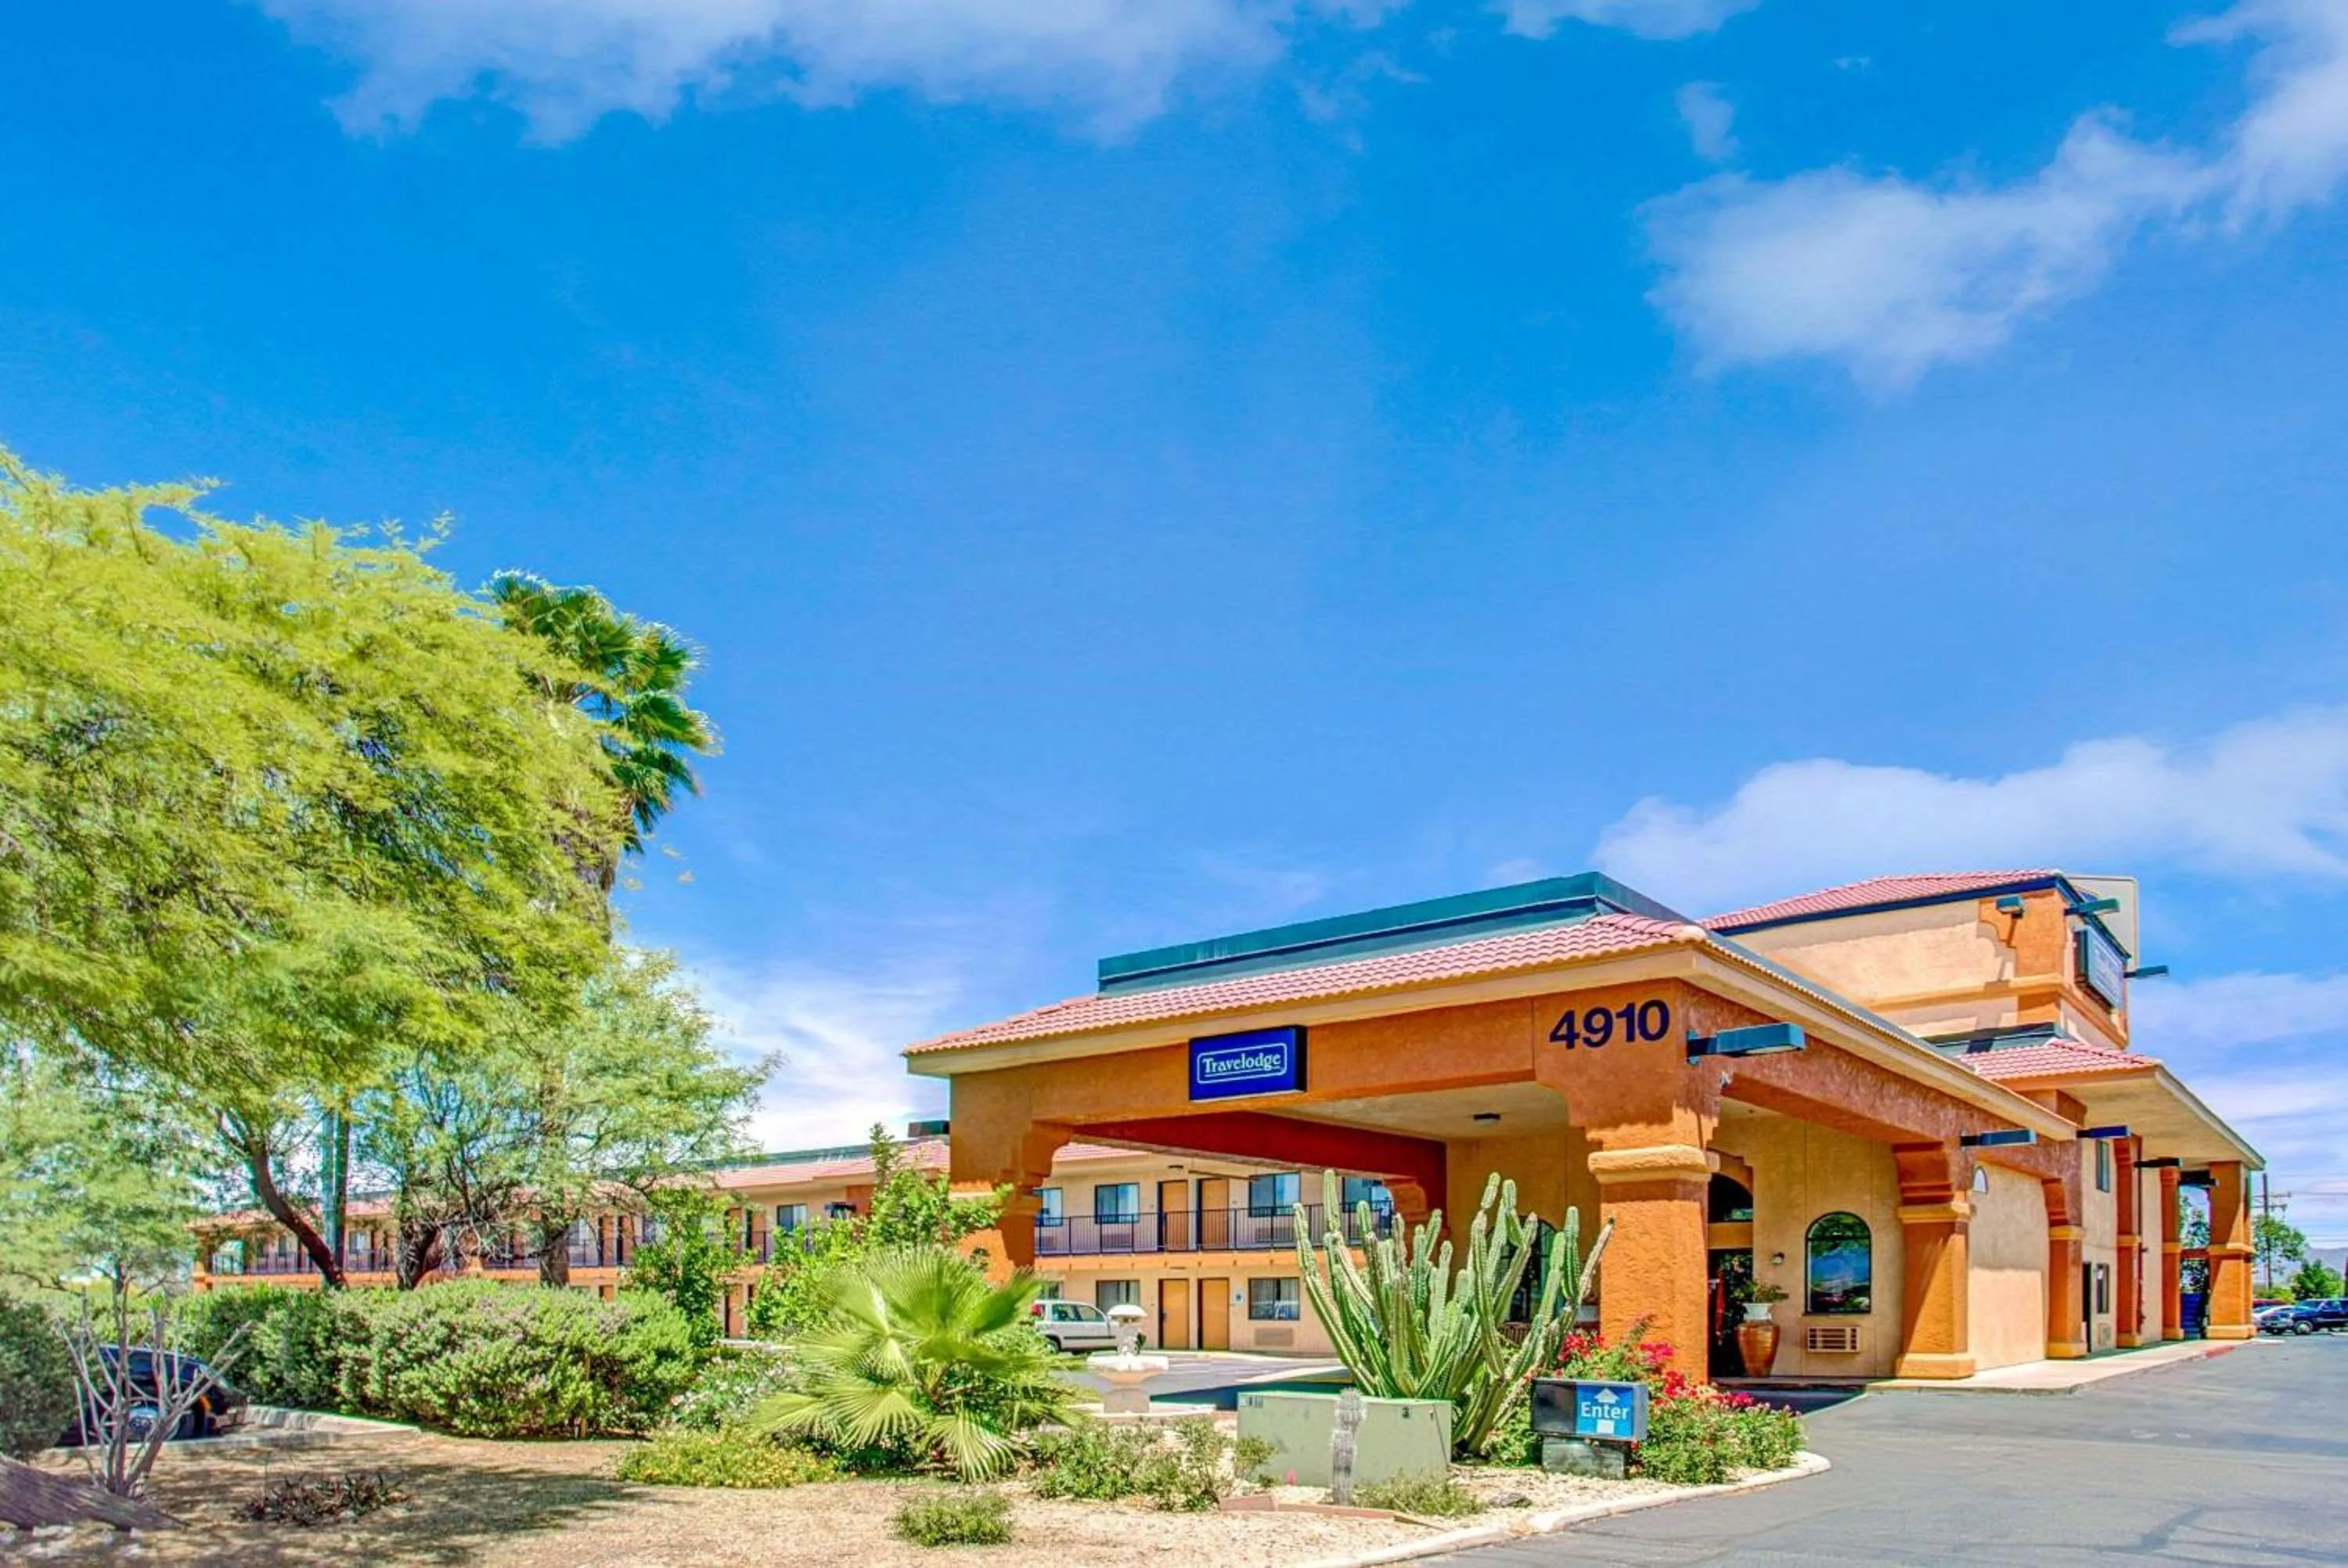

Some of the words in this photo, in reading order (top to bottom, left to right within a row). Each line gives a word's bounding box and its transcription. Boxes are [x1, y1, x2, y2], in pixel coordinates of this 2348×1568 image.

[1549, 999, 1669, 1049] 4910
[1202, 1052, 1281, 1074] Travelodge
[1580, 1401, 1629, 1419] Enter
